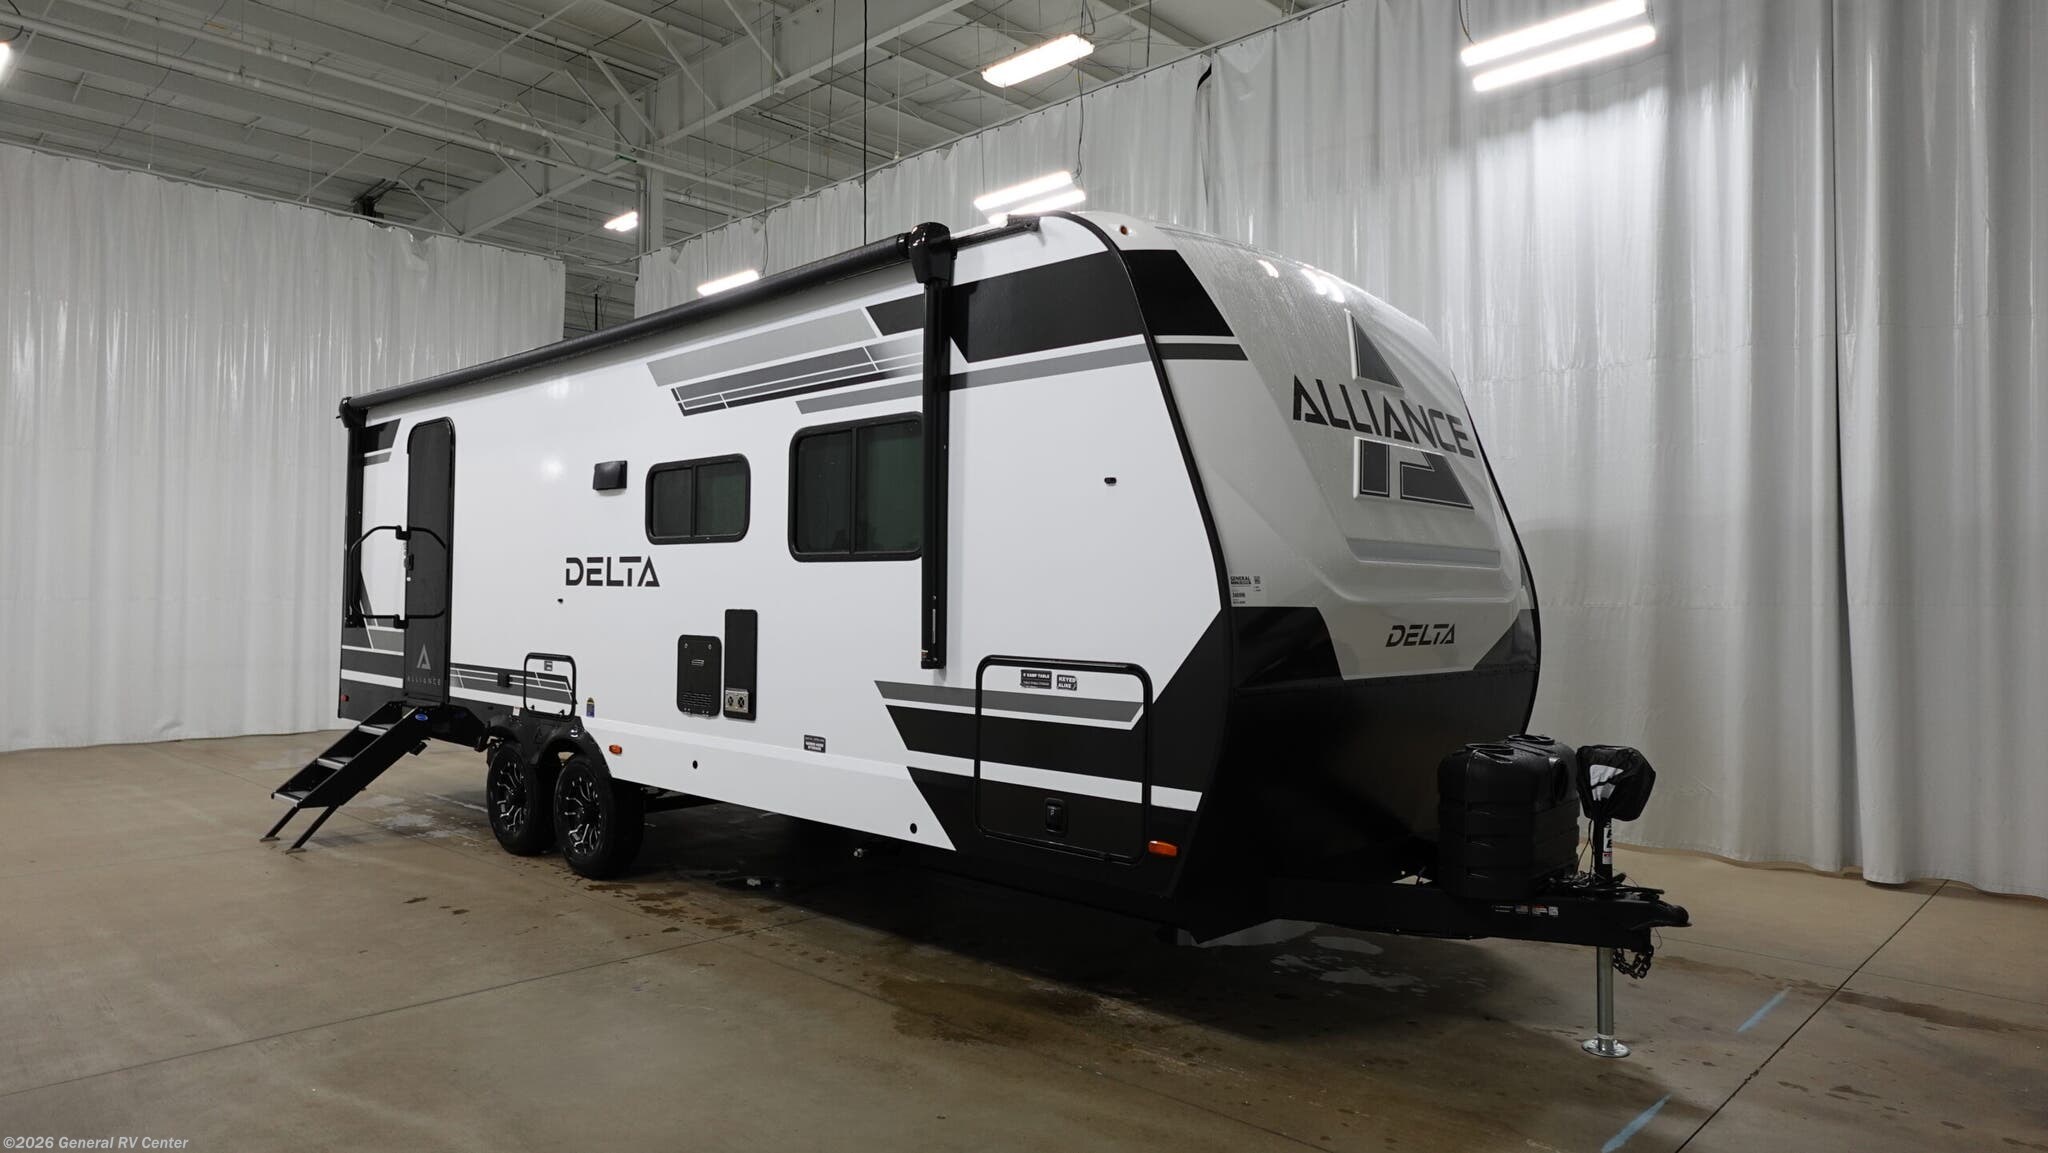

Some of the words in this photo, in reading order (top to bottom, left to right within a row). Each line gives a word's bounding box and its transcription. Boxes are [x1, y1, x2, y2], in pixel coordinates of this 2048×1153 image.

[1293, 375, 1476, 459] ALLIANCE
[565, 555, 660, 588] DELTA
[1385, 623, 1456, 648] DELTA
